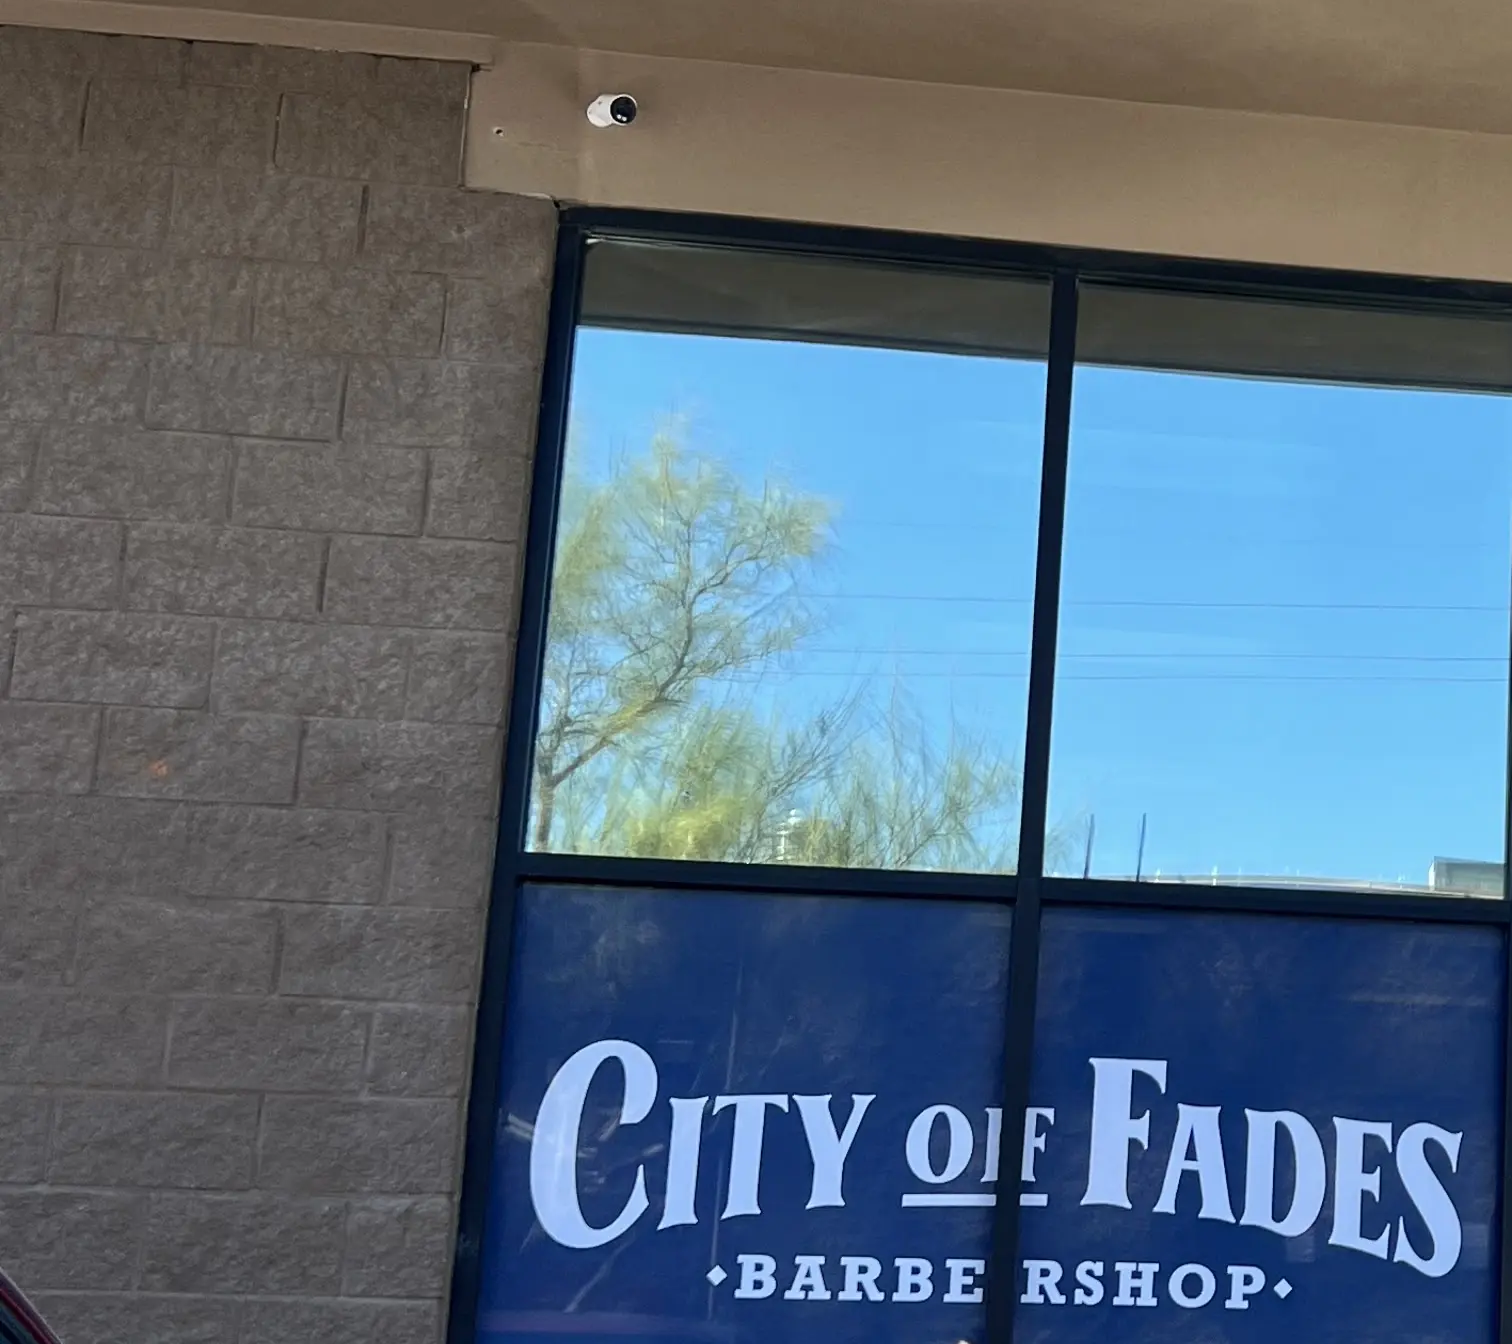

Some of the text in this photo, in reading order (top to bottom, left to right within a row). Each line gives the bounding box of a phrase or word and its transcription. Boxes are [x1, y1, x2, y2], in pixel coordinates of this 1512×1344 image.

[529, 1038, 877, 1249] CITY
[1079, 1056, 1464, 1278] FADES
[732, 1252, 1266, 1311] BARBERSHOP
